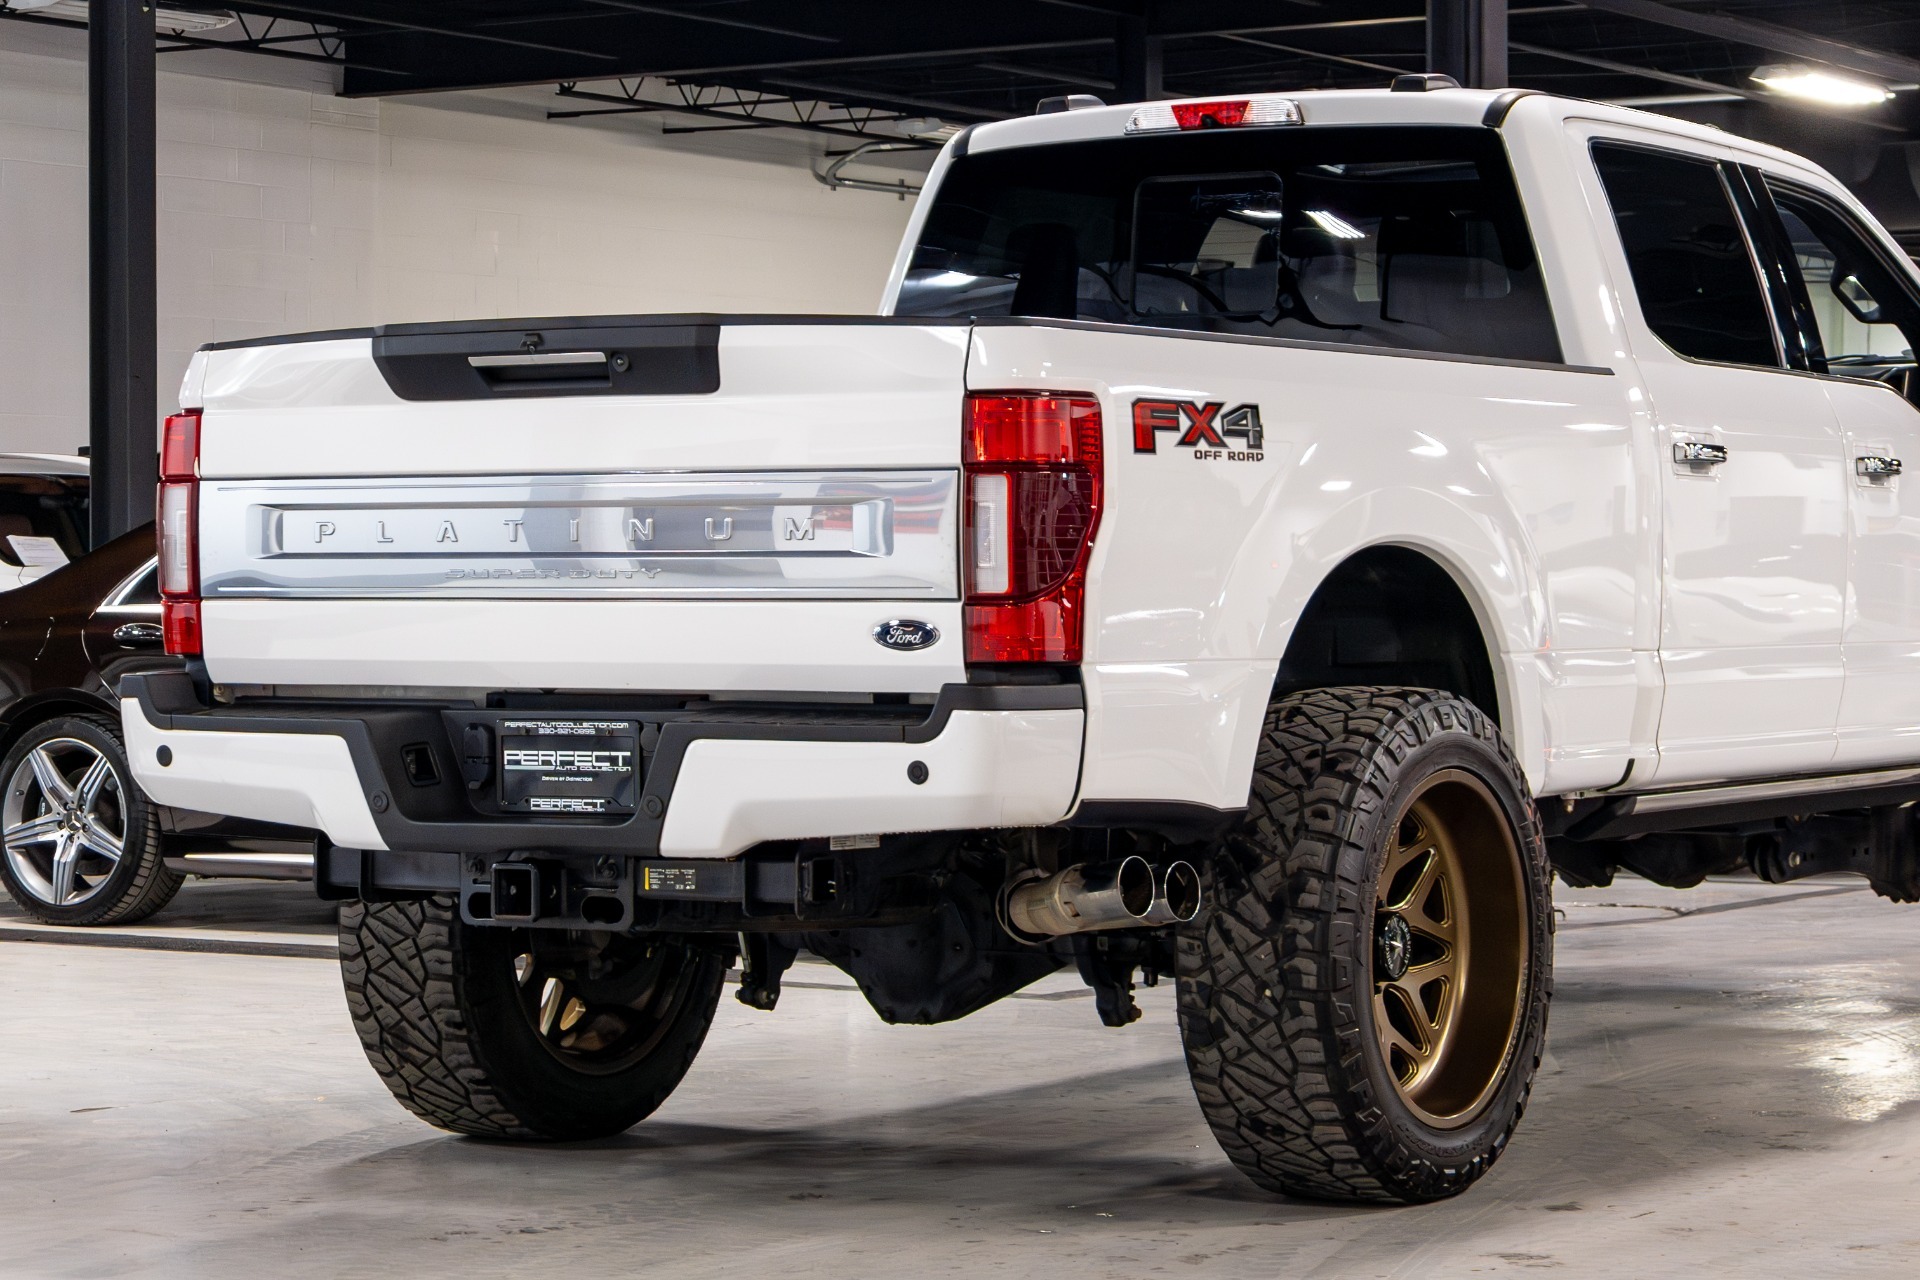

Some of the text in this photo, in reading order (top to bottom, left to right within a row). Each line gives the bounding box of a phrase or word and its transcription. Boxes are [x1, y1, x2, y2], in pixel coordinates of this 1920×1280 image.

[1131, 398, 1264, 455] FX4
[1194, 449, 1264, 462] OFF ROAD
[314, 517, 816, 543] PLATINUM
[445, 567, 662, 579] SUPER DUTY
[887, 626, 923, 643] Ford
[504, 750, 631, 766] PERFECT
[530, 798, 605, 808] PERFECT
